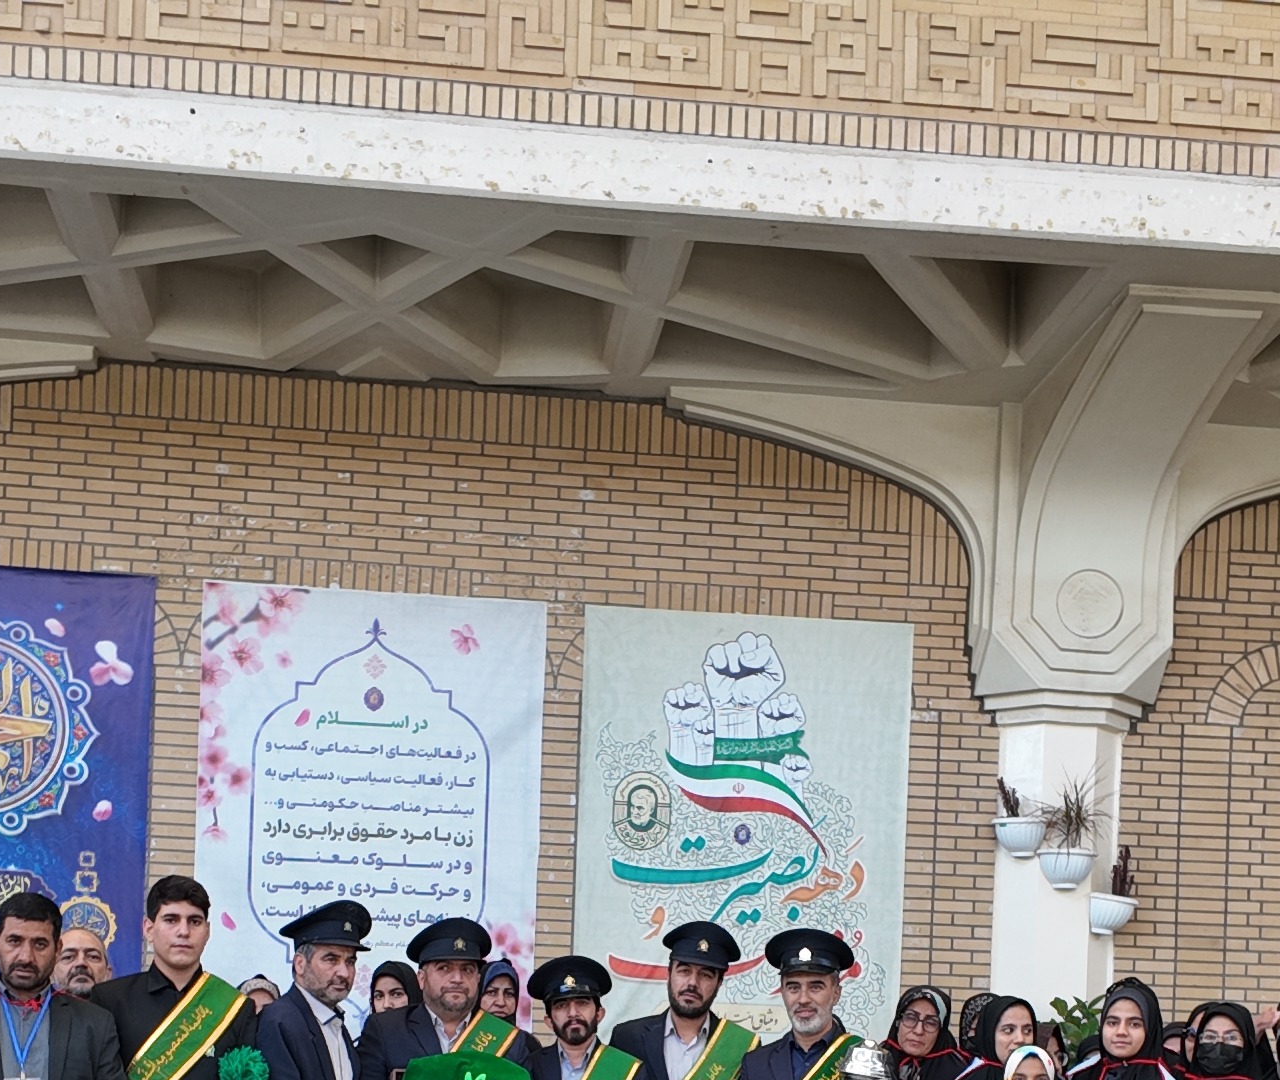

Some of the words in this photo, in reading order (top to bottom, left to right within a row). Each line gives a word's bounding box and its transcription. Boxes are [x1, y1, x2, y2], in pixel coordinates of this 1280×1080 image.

[316, 710, 409, 730] اسلام
[412, 716, 428, 733] در
[265, 741, 273, 753] و
[274, 740, 309, 755] کسب
[464, 750, 477, 764] در
[264, 767, 276, 781] به
[278, 767, 334, 783] دستیابی
[393, 774, 443, 788] فعالیت
[286, 797, 359, 812] حکومتی
[361, 800, 421, 813] مناصب
[422, 803, 474, 819] بیشتر
[263, 818, 291, 838] دارد
[292, 820, 345, 842] برابری
[346, 822, 397, 842] حقوق
[400, 825, 432, 845] مرد
[434, 826, 451, 846] با
[453, 829, 473, 847] زن
[261, 850, 359, 866] معنوی
[362, 852, 443, 871] سلوک
[446, 862, 460, 874] در
[464, 861, 473, 874] و
[338, 881, 346, 896] و
[350, 877, 398, 897] فردی
[402, 882, 459, 900] حرکت
[463, 887, 472, 902] و
